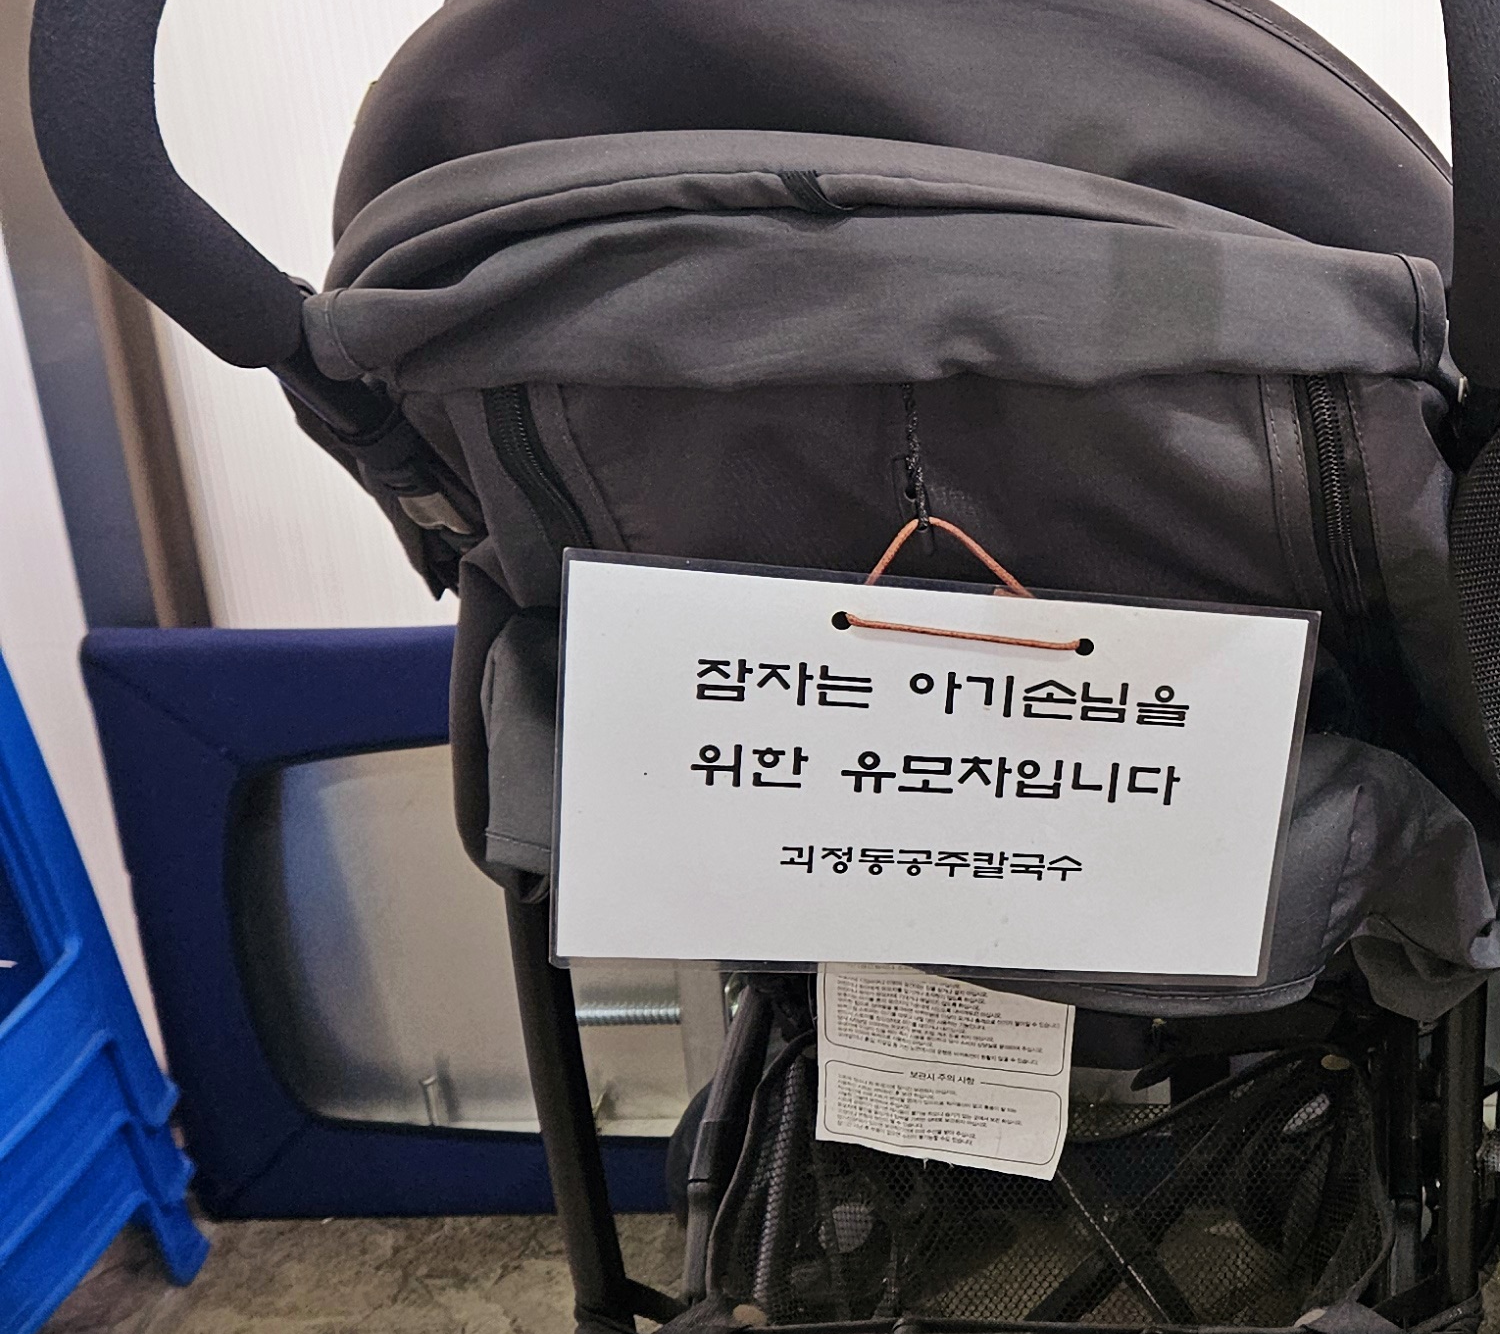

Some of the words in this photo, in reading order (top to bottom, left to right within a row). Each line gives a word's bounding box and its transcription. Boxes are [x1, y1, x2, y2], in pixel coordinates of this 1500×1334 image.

[696, 658, 873, 709] 잠자는
[909, 671, 1190, 728] 아기손님을
[690, 743, 809, 789] 위한
[840, 750, 1181, 806] 유모차입니다
[779, 845, 1083, 882] 괴정동공주칼국수
[910, 1071, 935, 1081] 보관시
[937, 1073, 956, 1083] 주의
